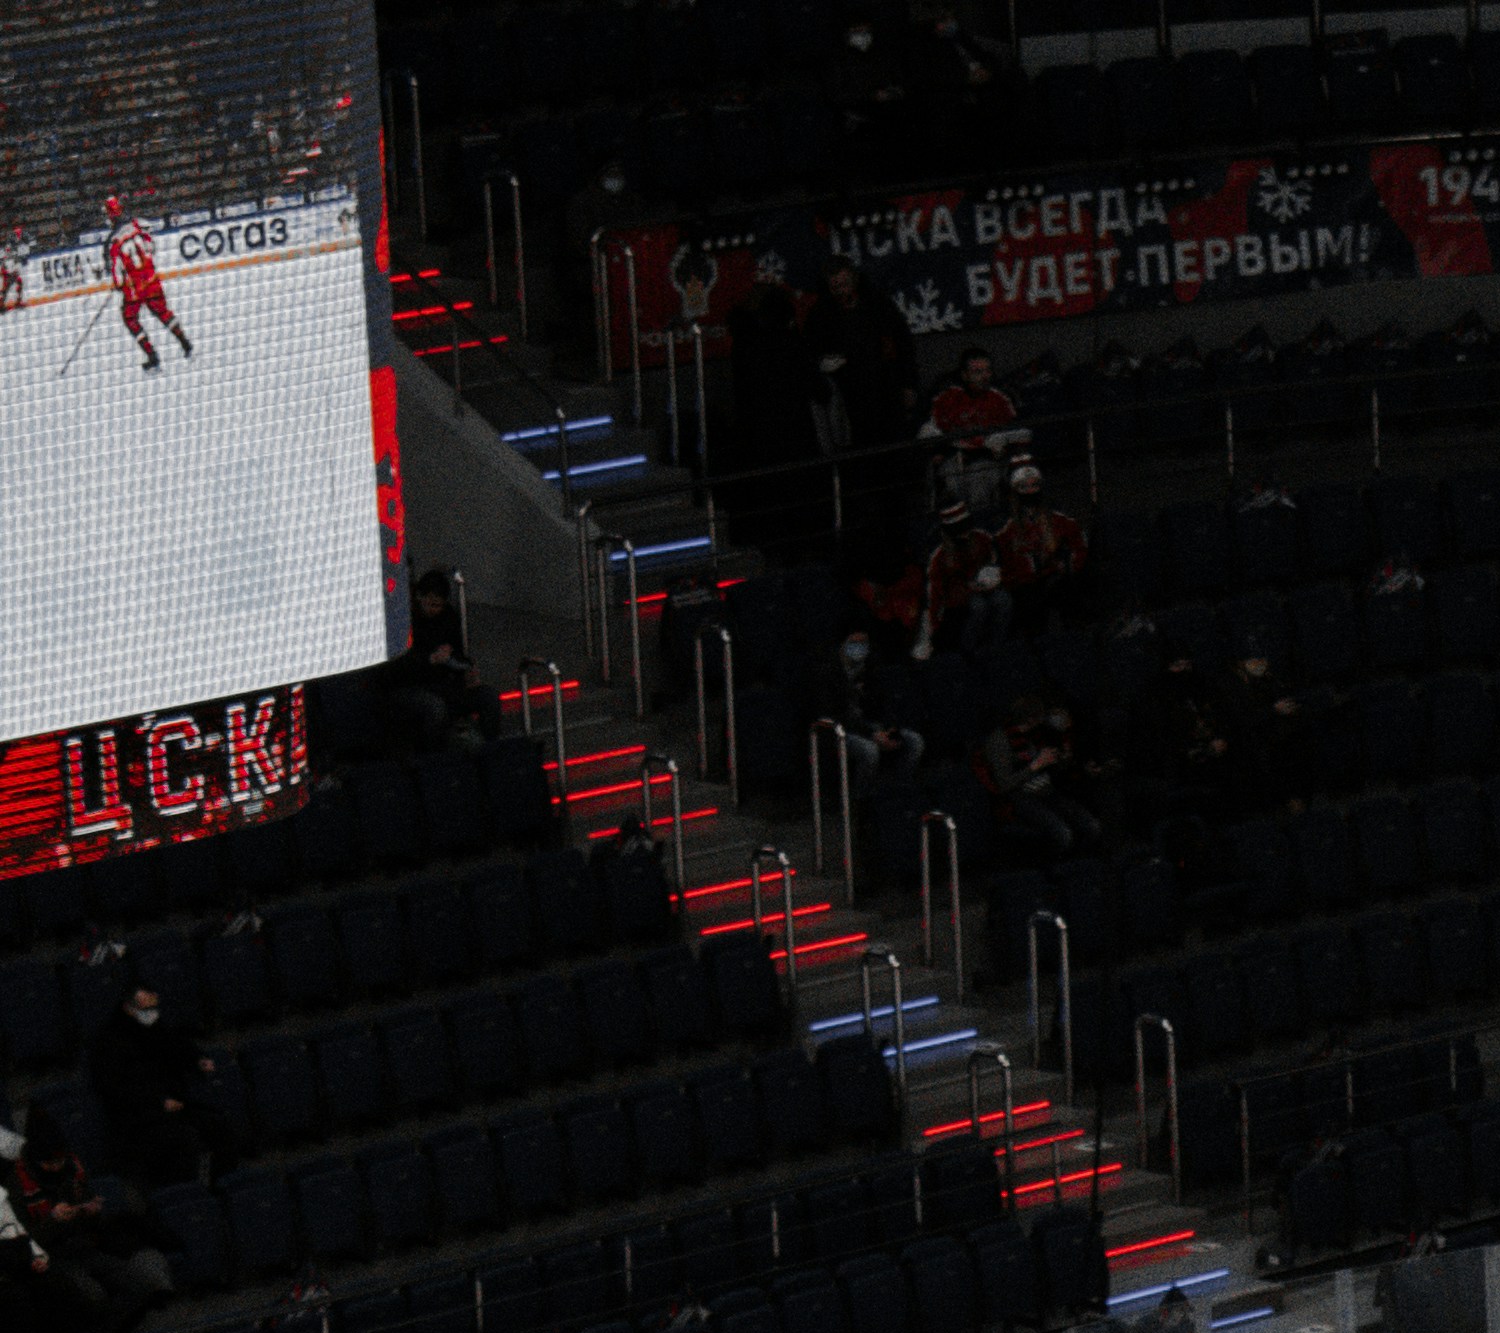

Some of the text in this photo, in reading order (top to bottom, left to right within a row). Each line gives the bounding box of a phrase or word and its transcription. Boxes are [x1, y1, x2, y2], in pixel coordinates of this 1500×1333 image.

[829, 188, 1171, 268] ЦСКА ВСЕГДА
[965, 222, 1376, 308] БУДЕТ ПЕРВЫМ!
